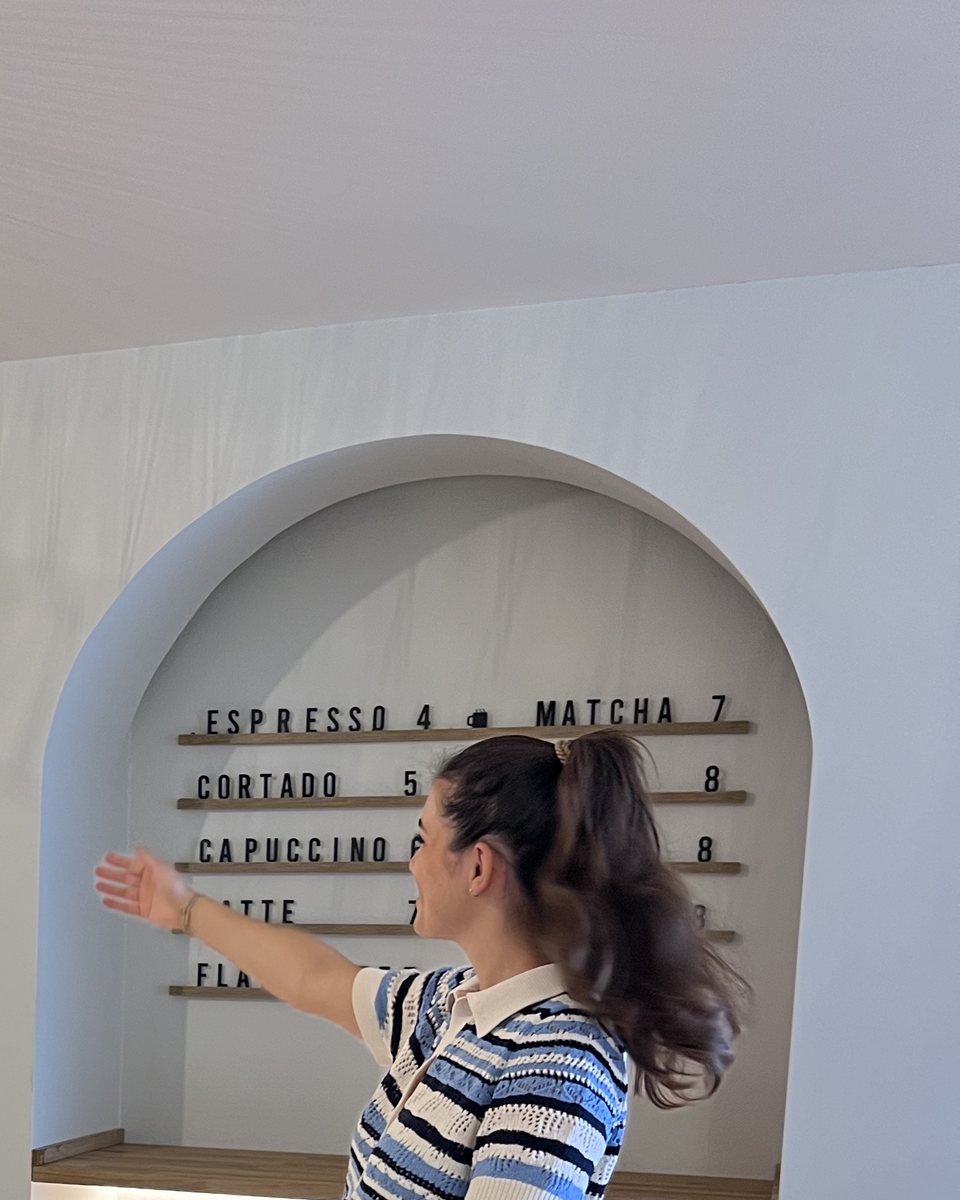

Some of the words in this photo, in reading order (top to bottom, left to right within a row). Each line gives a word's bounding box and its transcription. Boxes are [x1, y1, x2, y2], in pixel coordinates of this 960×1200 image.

[206, 705, 386, 735] ESPRESSO
[416, 704, 432, 730] 4
[536, 697, 673, 727] MATCHA
[712, 695, 727, 722] 7
[197, 772, 337, 799] CORTADO
[404, 770, 418, 796] 5
[704, 765, 720, 792] 8
[199, 836, 387, 862] CAPUCCINO
[697, 836, 712, 862] 8
[221, 899, 295, 925] TTE
